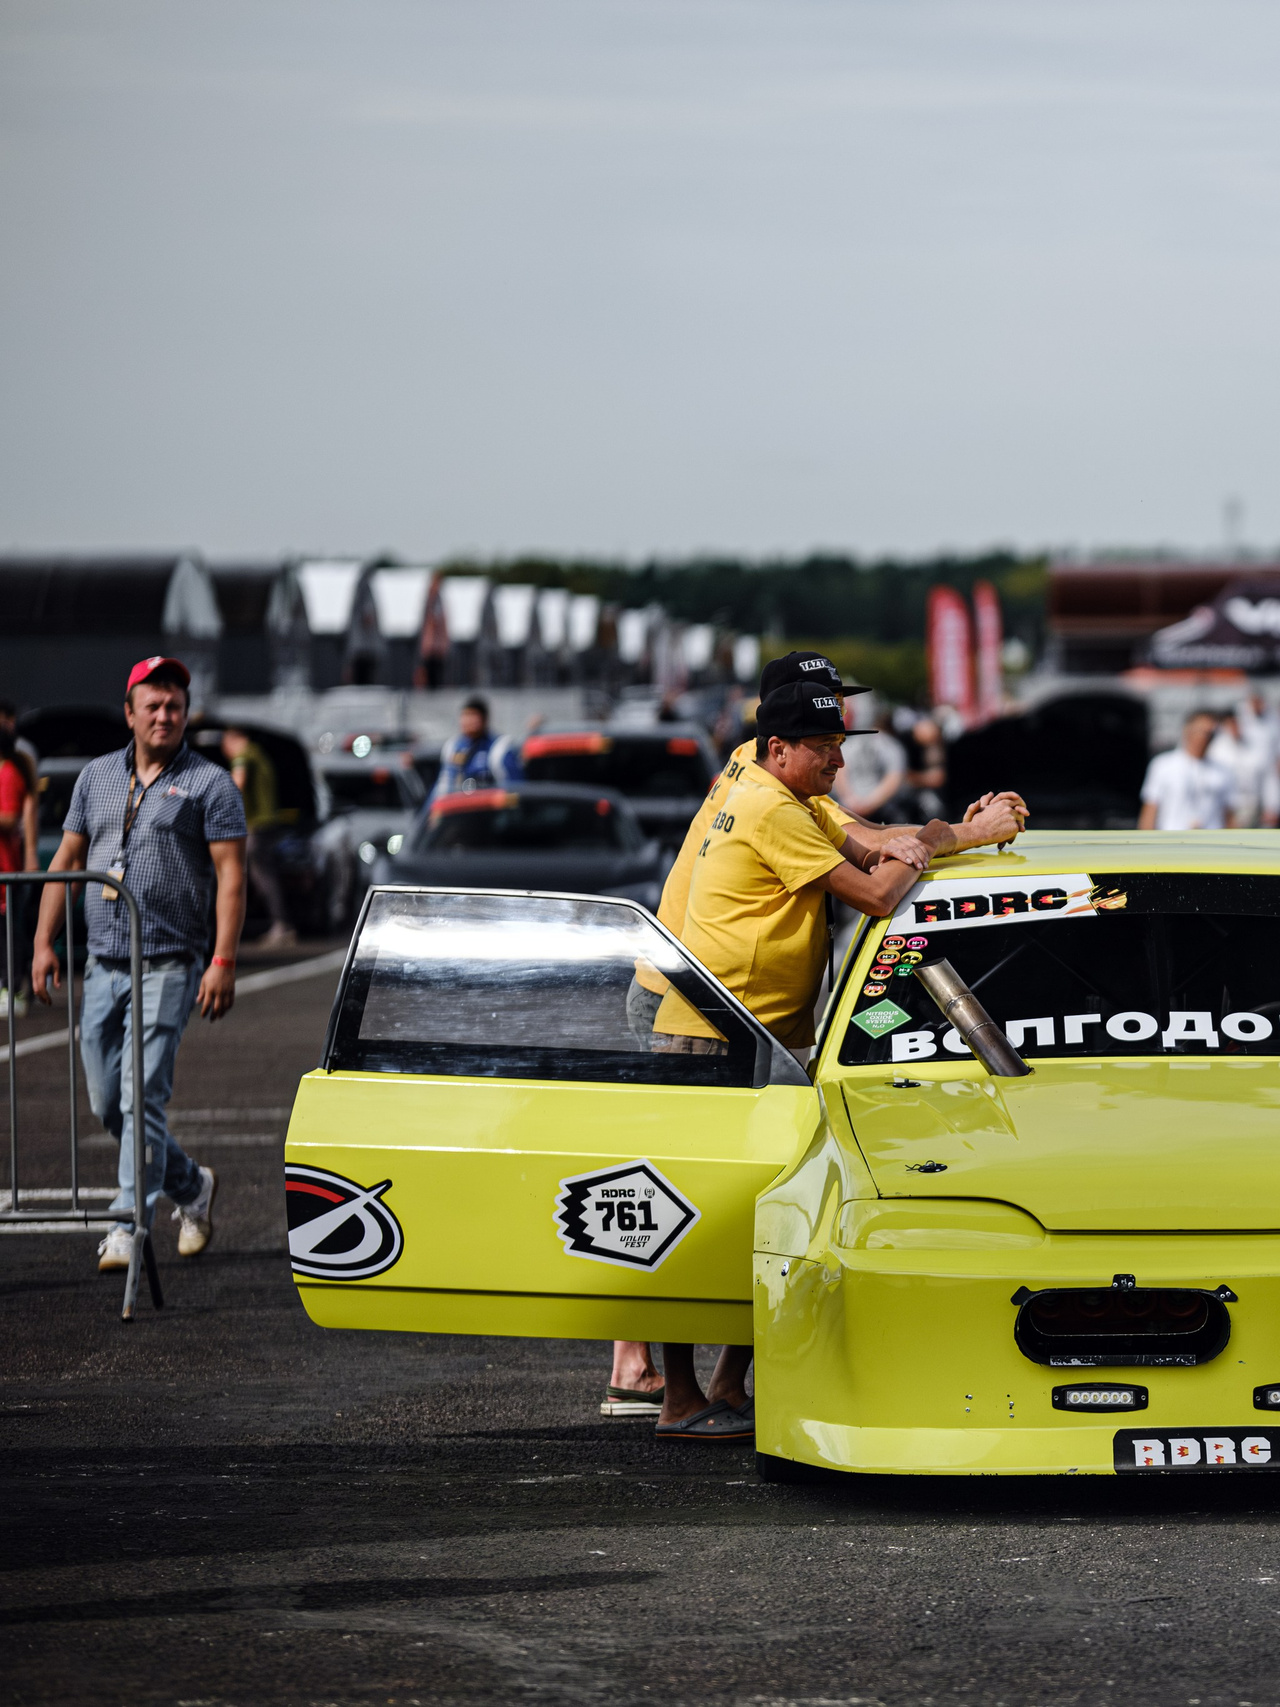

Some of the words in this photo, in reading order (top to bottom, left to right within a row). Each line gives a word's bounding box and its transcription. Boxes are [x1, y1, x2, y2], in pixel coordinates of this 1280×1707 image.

[911, 887, 1068, 924] RDRC
[601, 1188, 636, 1199] RDRC
[595, 1200, 659, 1232] 761
[1131, 1436, 1272, 1467] RDRC
